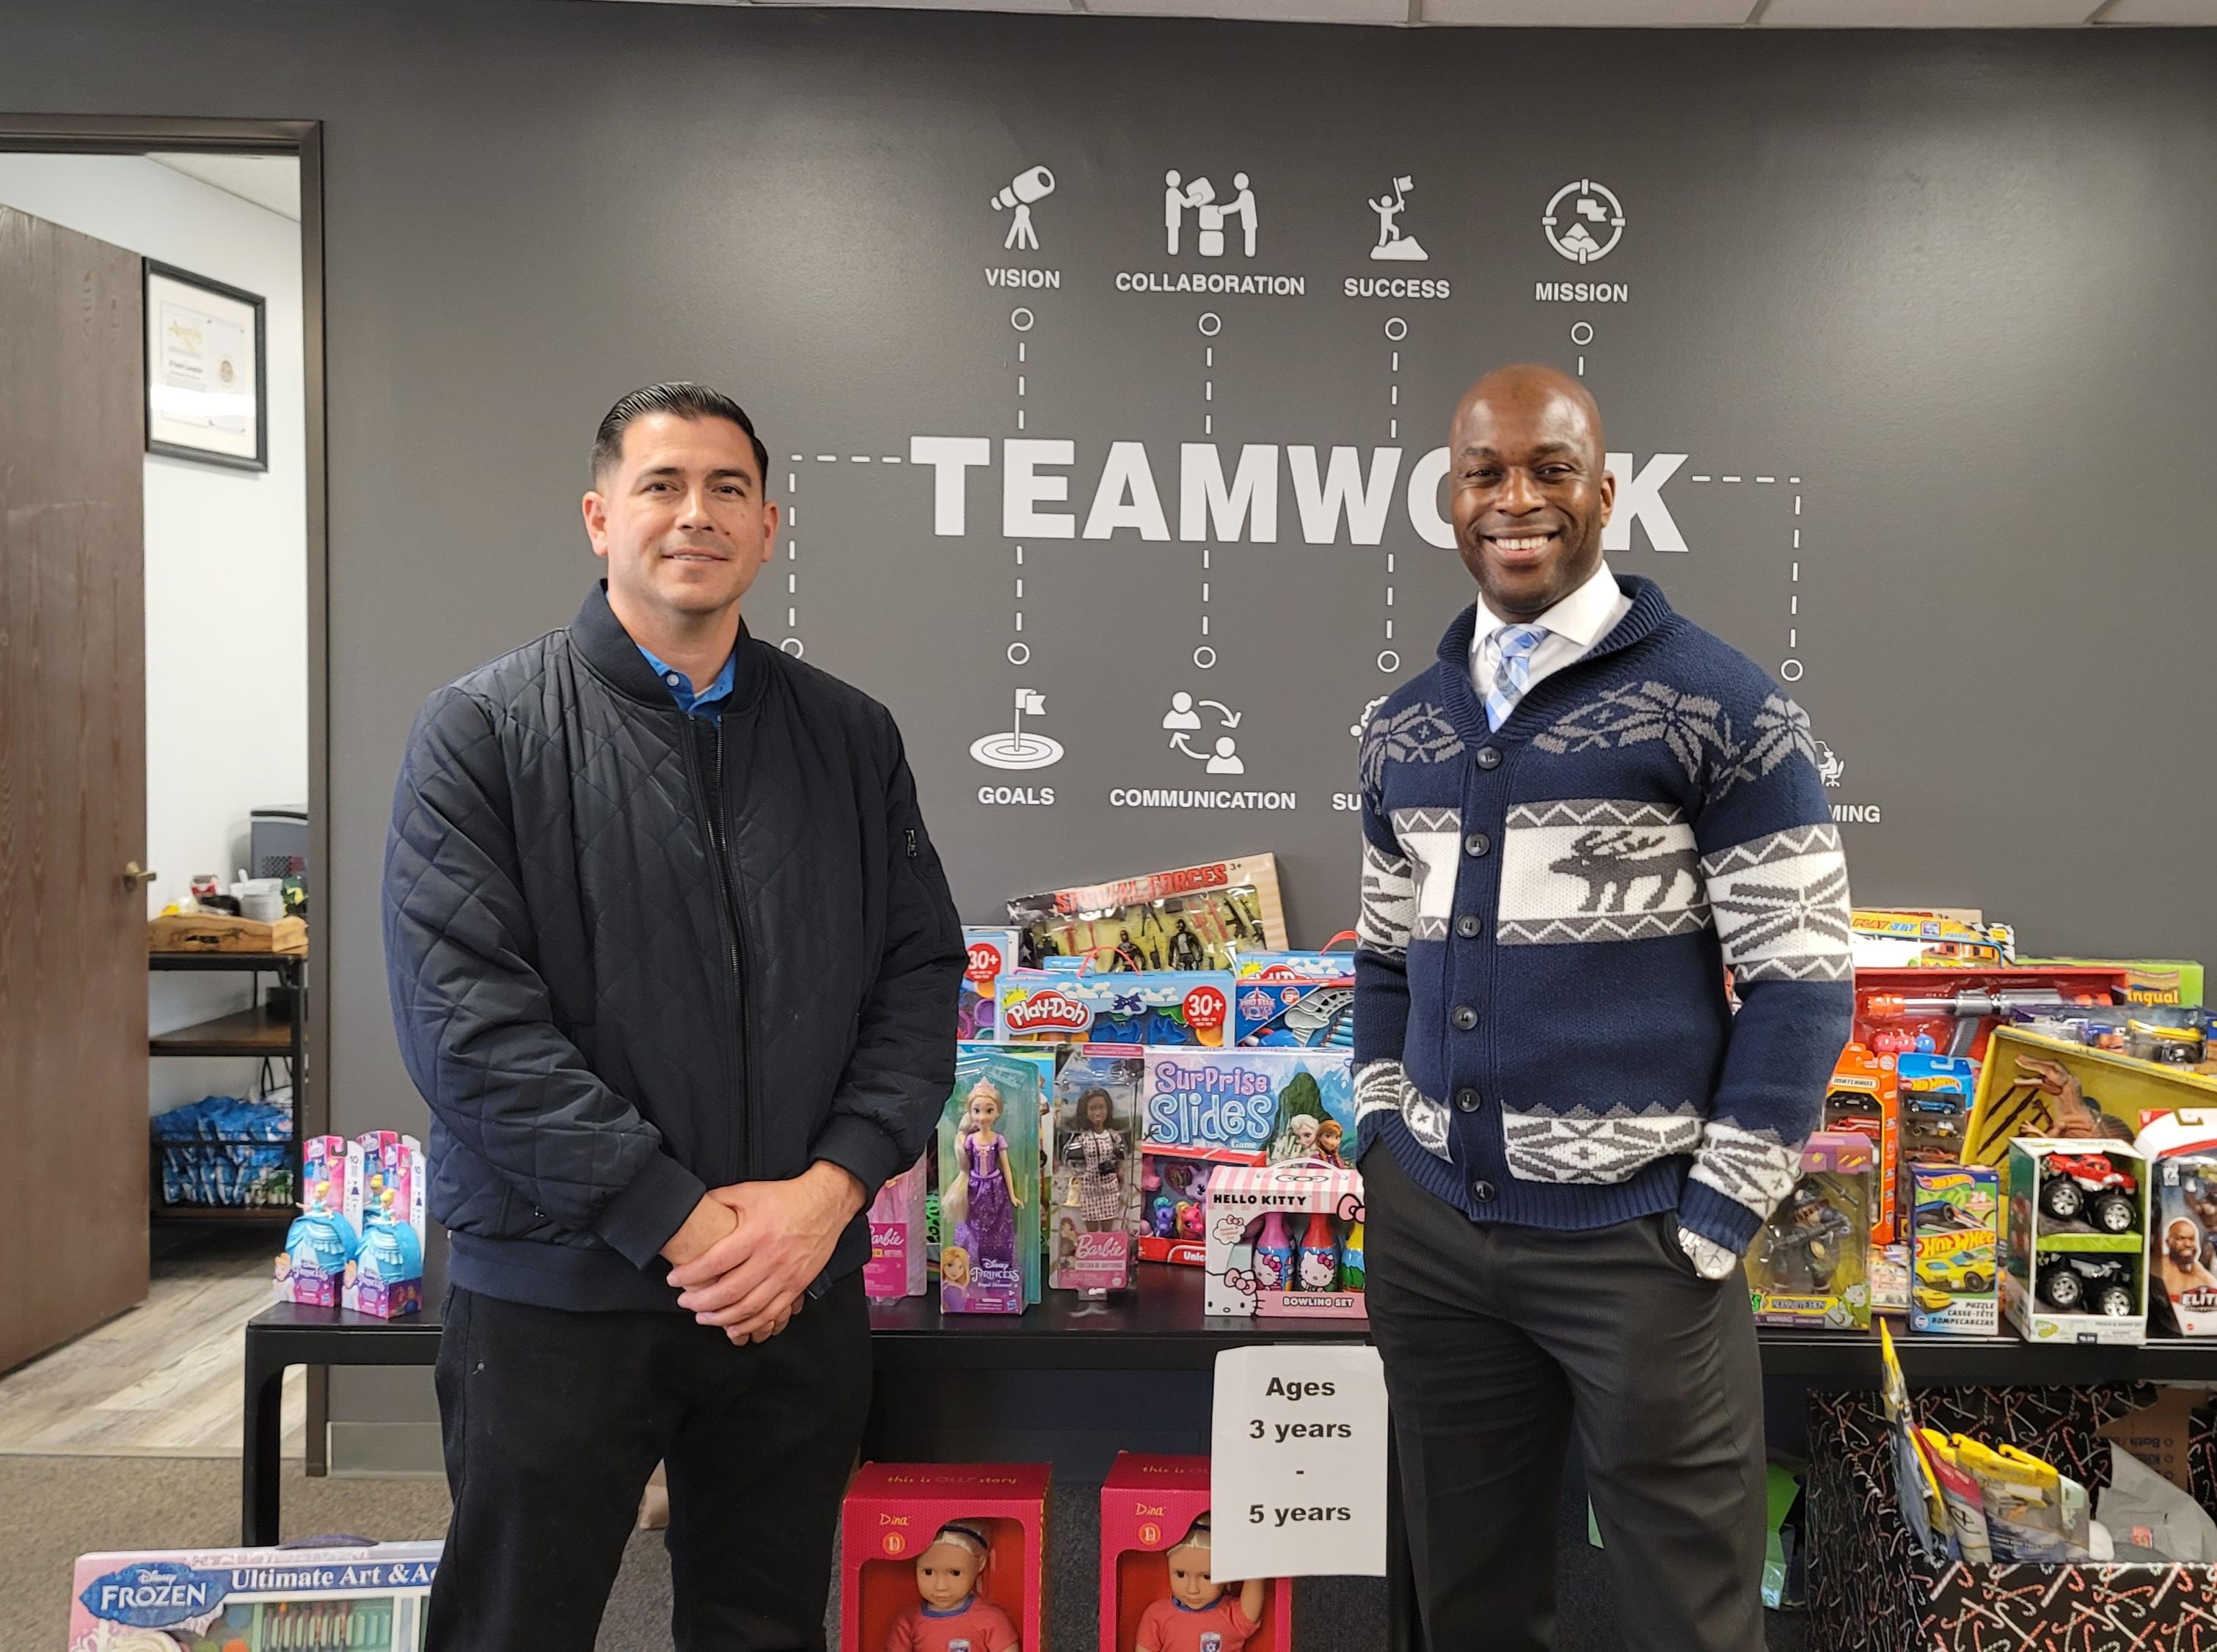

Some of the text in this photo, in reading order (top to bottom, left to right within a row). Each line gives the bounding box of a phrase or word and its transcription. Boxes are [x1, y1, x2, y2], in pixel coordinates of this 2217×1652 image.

[985, 268, 1060, 290] VISION
[1115, 271, 1306, 296] COLLABORATION
[1343, 277, 1450, 300] SUCCESS
[1534, 282, 1629, 304] MISSION
[910, 436, 1690, 553] TEAMWOK
[978, 787, 1055, 806] GOALS
[1109, 789, 1296, 811] COMMUNICATION
[1332, 793, 1362, 812] SU
[1852, 918, 1889, 929] PLAY
[968, 950, 998, 970] 30+
[1188, 994, 1224, 1017] 30+
[2127, 990, 2179, 1007] ingual
[1150, 1092, 1273, 1144] Slides
[1231, 1140, 1256, 1149] Game
[1213, 1194, 1307, 1206] HELLO KITTY
[1075, 1234, 1126, 1259] Barbie
[1183, 1251, 1206, 1262] Unic
[981, 1258, 1010, 1271] Disney
[1282, 1296, 1354, 1308] BOWLING SET
[1931, 1317, 1995, 1326] ROMPECABEZAS
[1265, 1377, 1336, 1401] Ages
[1249, 1419, 1352, 1443] 3 years
[888, 1475, 914, 1483] this
[979, 1476, 1018, 1485] story
[1136, 1502, 1164, 1516] Dina
[1249, 1504, 1351, 1527] 5 years
[879, 1513, 909, 1526] Dina
[136, 1568, 177, 1585] Disney
[230, 1567, 335, 1590] Ultimate
[339, 1564, 381, 1586] Art
[101, 1582, 208, 1610] FROZEN
